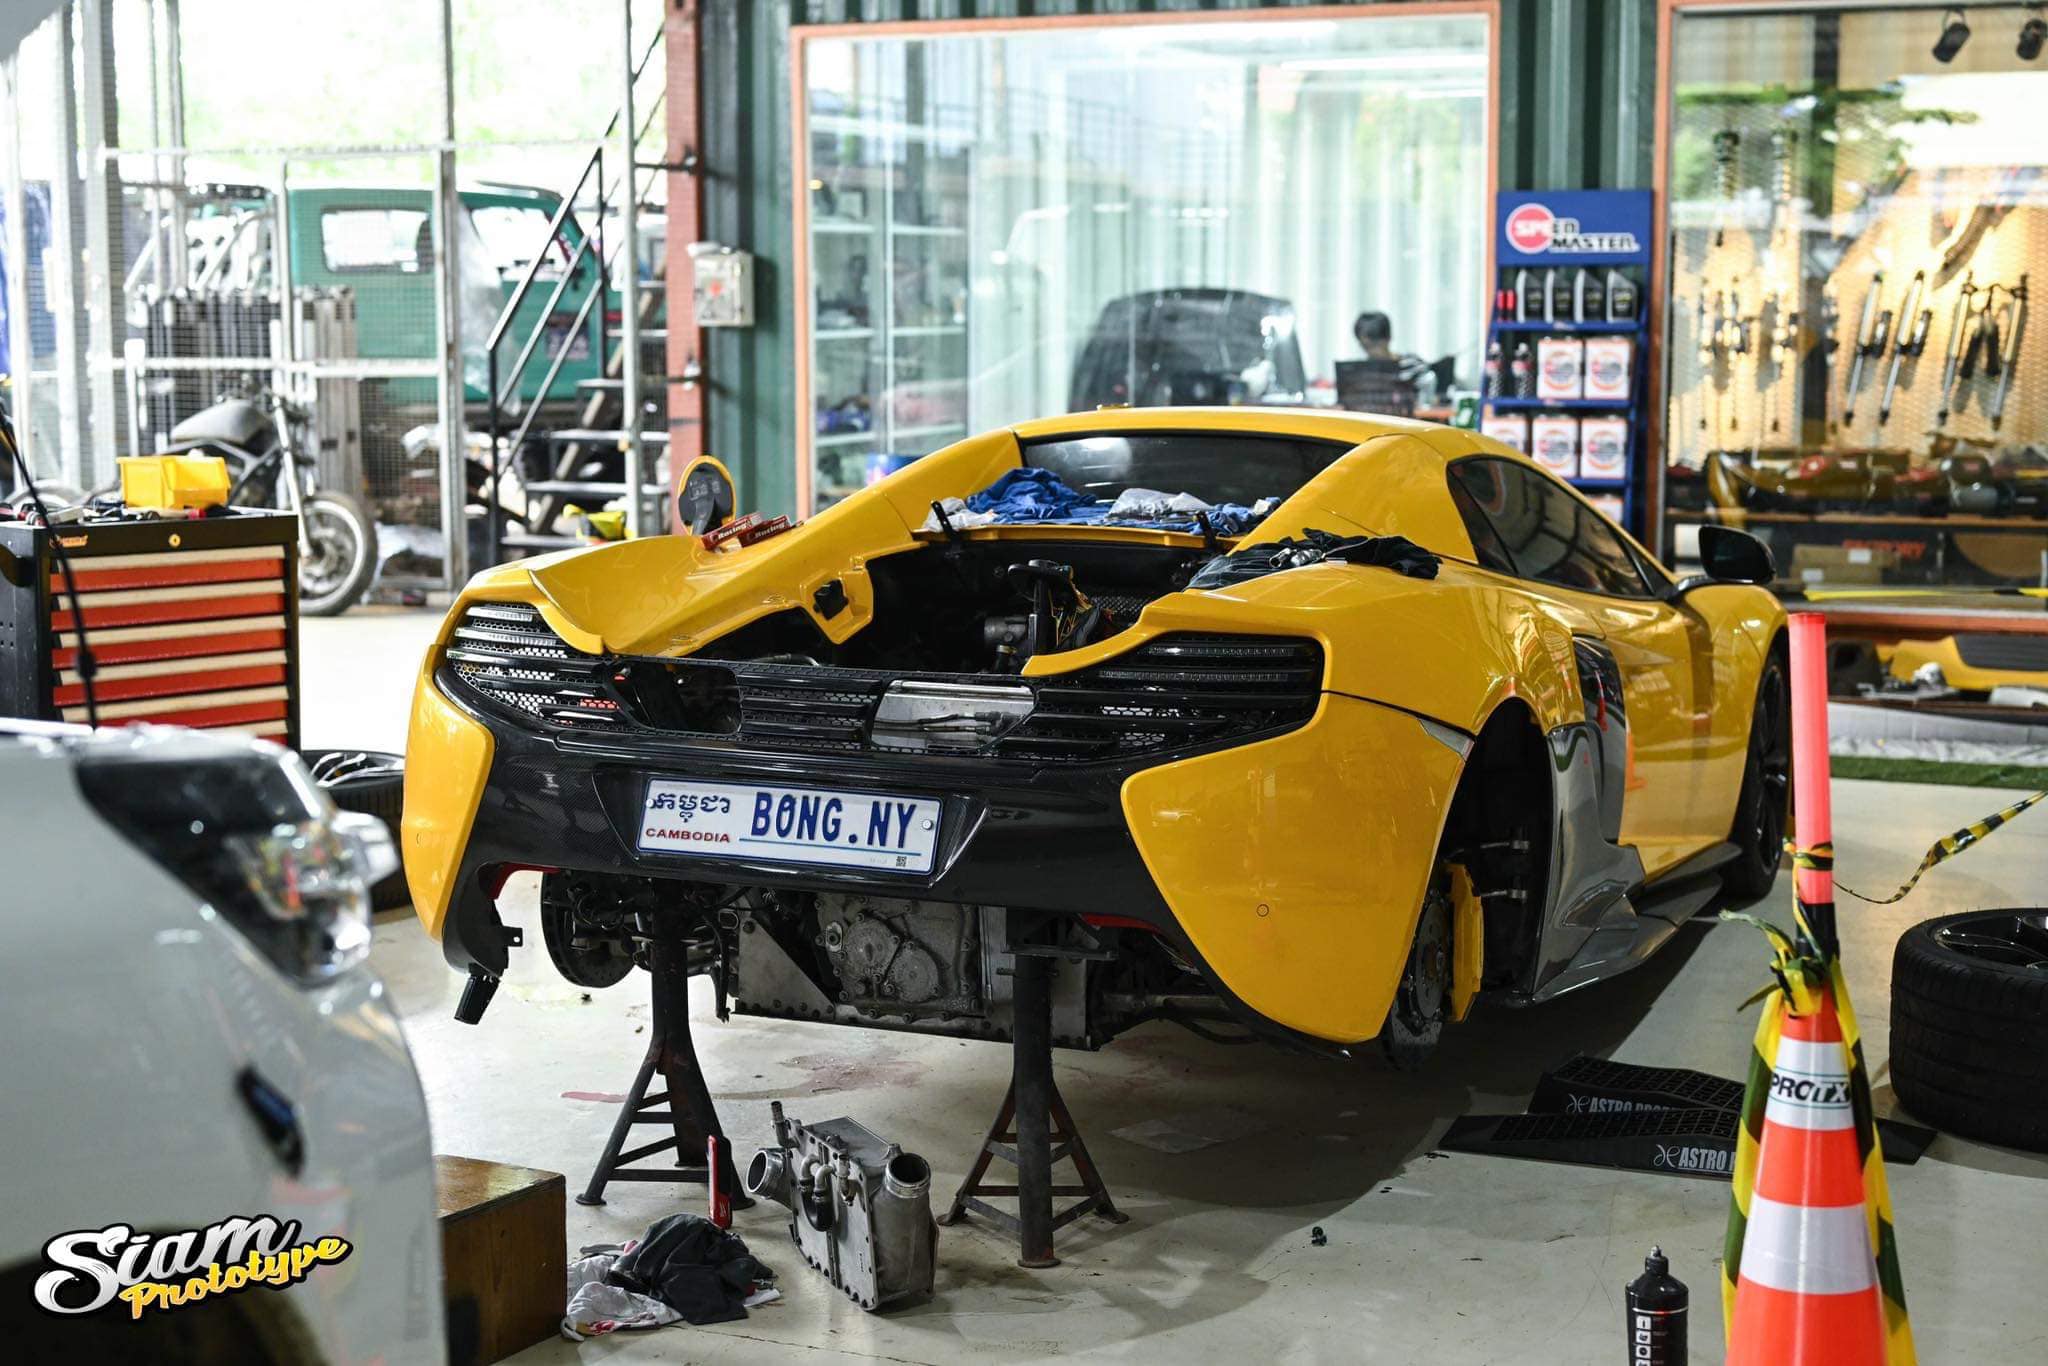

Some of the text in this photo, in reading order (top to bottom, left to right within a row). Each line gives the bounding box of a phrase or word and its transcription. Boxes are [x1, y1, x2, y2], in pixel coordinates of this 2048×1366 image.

[1550, 237, 1633, 250] MASTER
[645, 827, 731, 843] CAMBODIA
[1678, 1146, 1728, 1172] ASTRO
